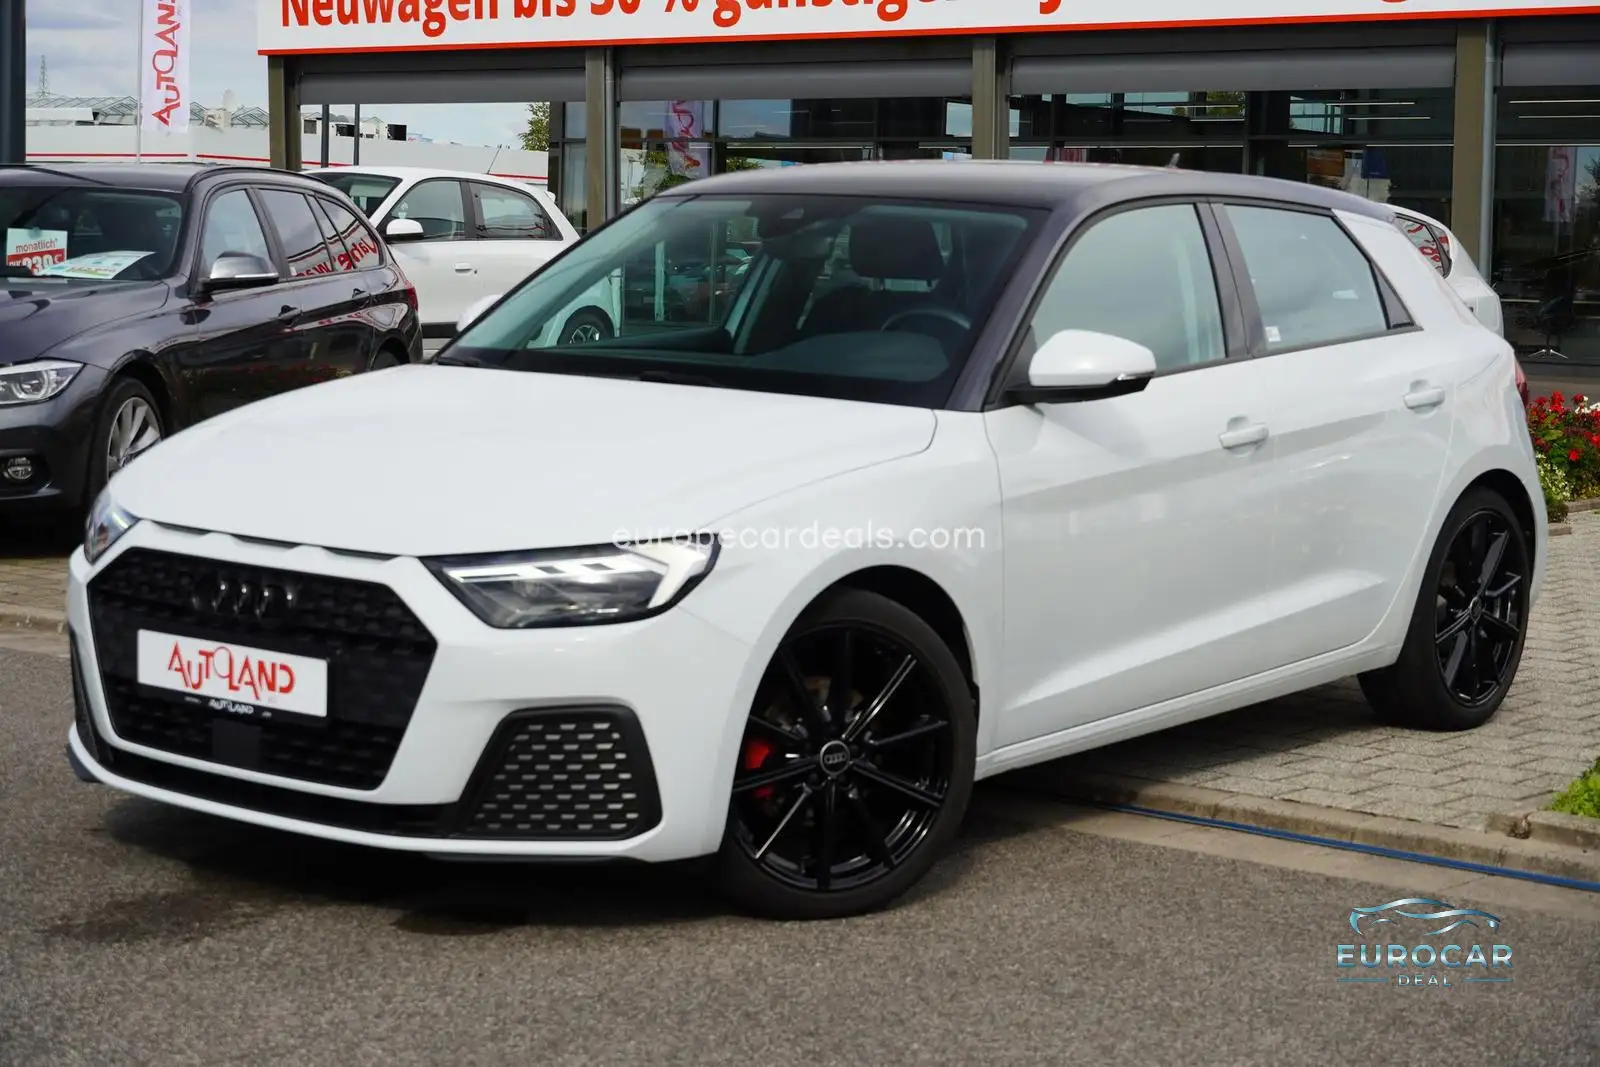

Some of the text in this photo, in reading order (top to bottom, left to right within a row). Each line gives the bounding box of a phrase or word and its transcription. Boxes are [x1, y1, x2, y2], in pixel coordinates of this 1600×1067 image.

[282, 0, 498, 37] Neuwagen
[152, 0, 181, 127] AUTOLAN
[168, 641, 297, 701] AUTOLAND
